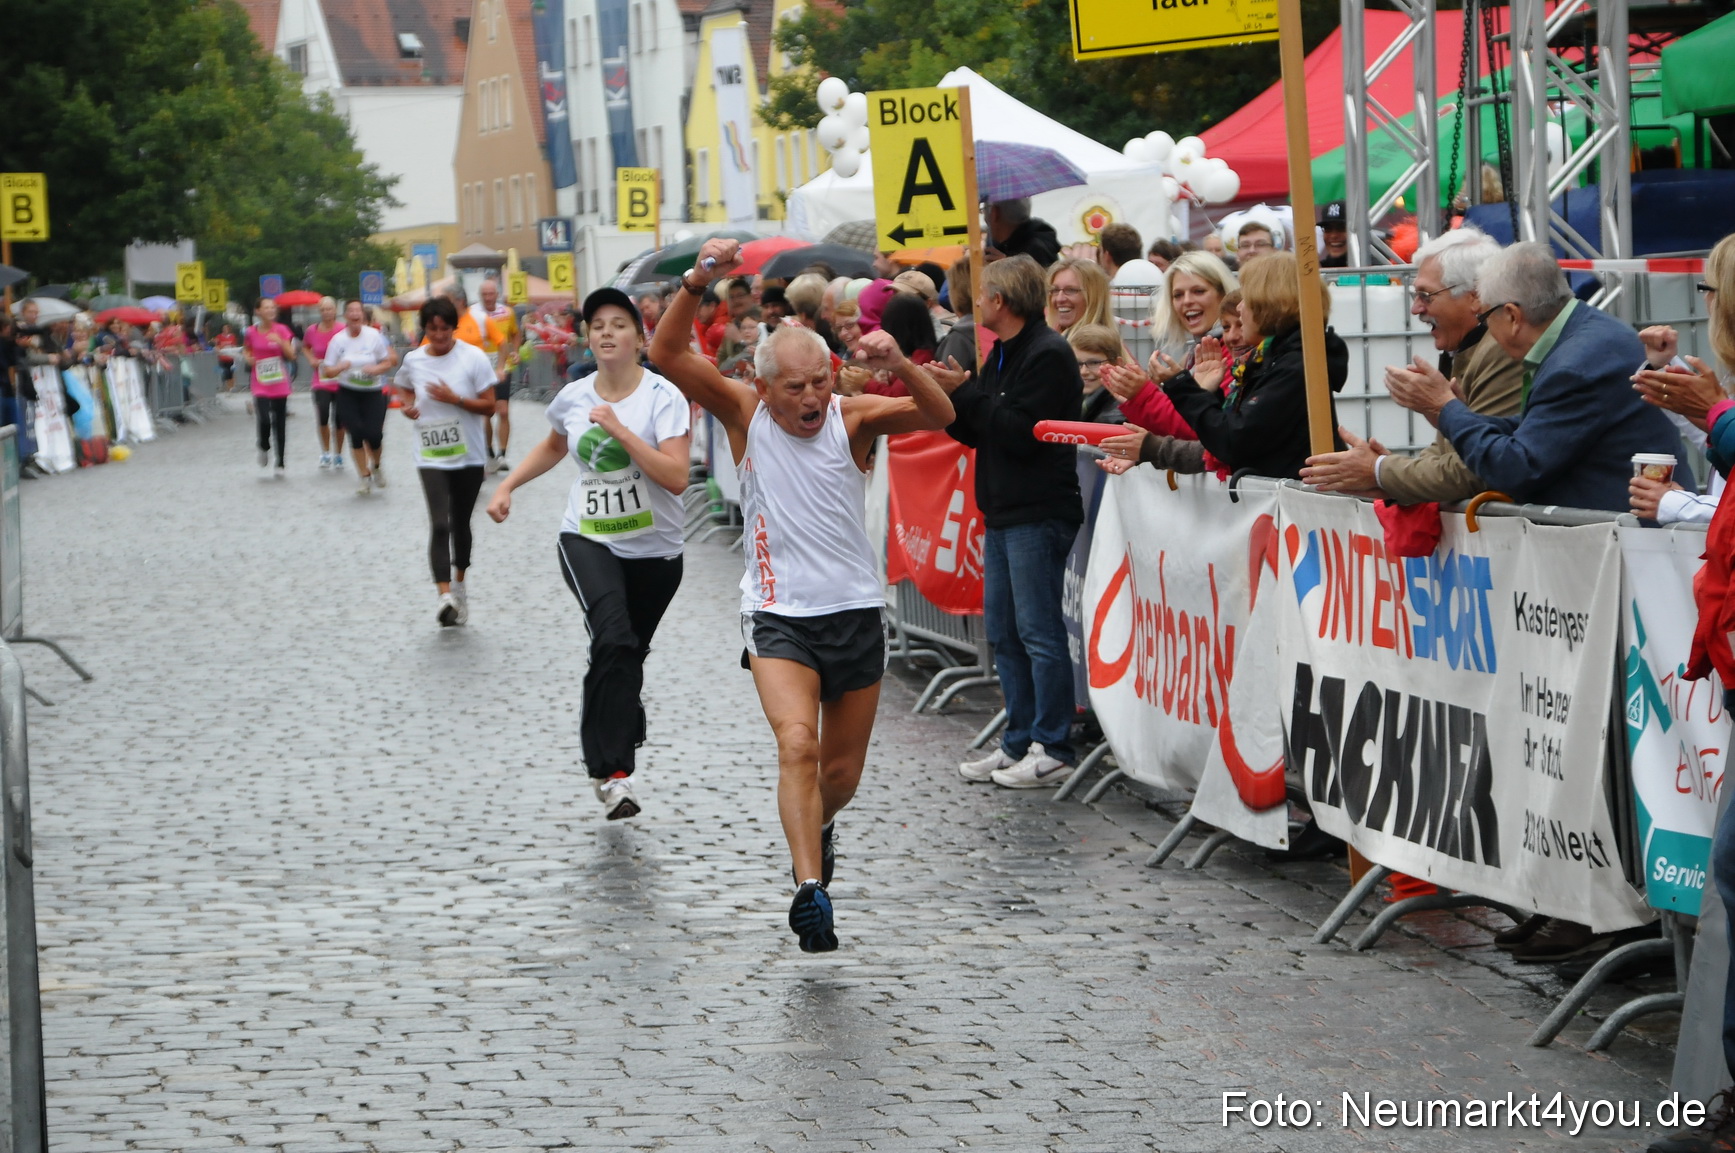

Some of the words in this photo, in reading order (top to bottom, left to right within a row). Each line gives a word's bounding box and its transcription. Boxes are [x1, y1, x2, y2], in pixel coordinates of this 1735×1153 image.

[879, 94, 960, 126] Block
[622, 170, 656, 182] Block
[897, 137, 956, 214] A
[12, 193, 33, 224] B
[629, 187, 649, 218] B
[181, 273, 194, 292] C
[554, 264, 568, 283] C
[208, 288, 220, 304] D
[512, 281, 523, 296] D
[421, 427, 460, 447] 5043
[586, 483, 641, 515] 5111
[593, 518, 638, 532] Elisabeth
[1318, 526, 1497, 674] INTERSPORT
